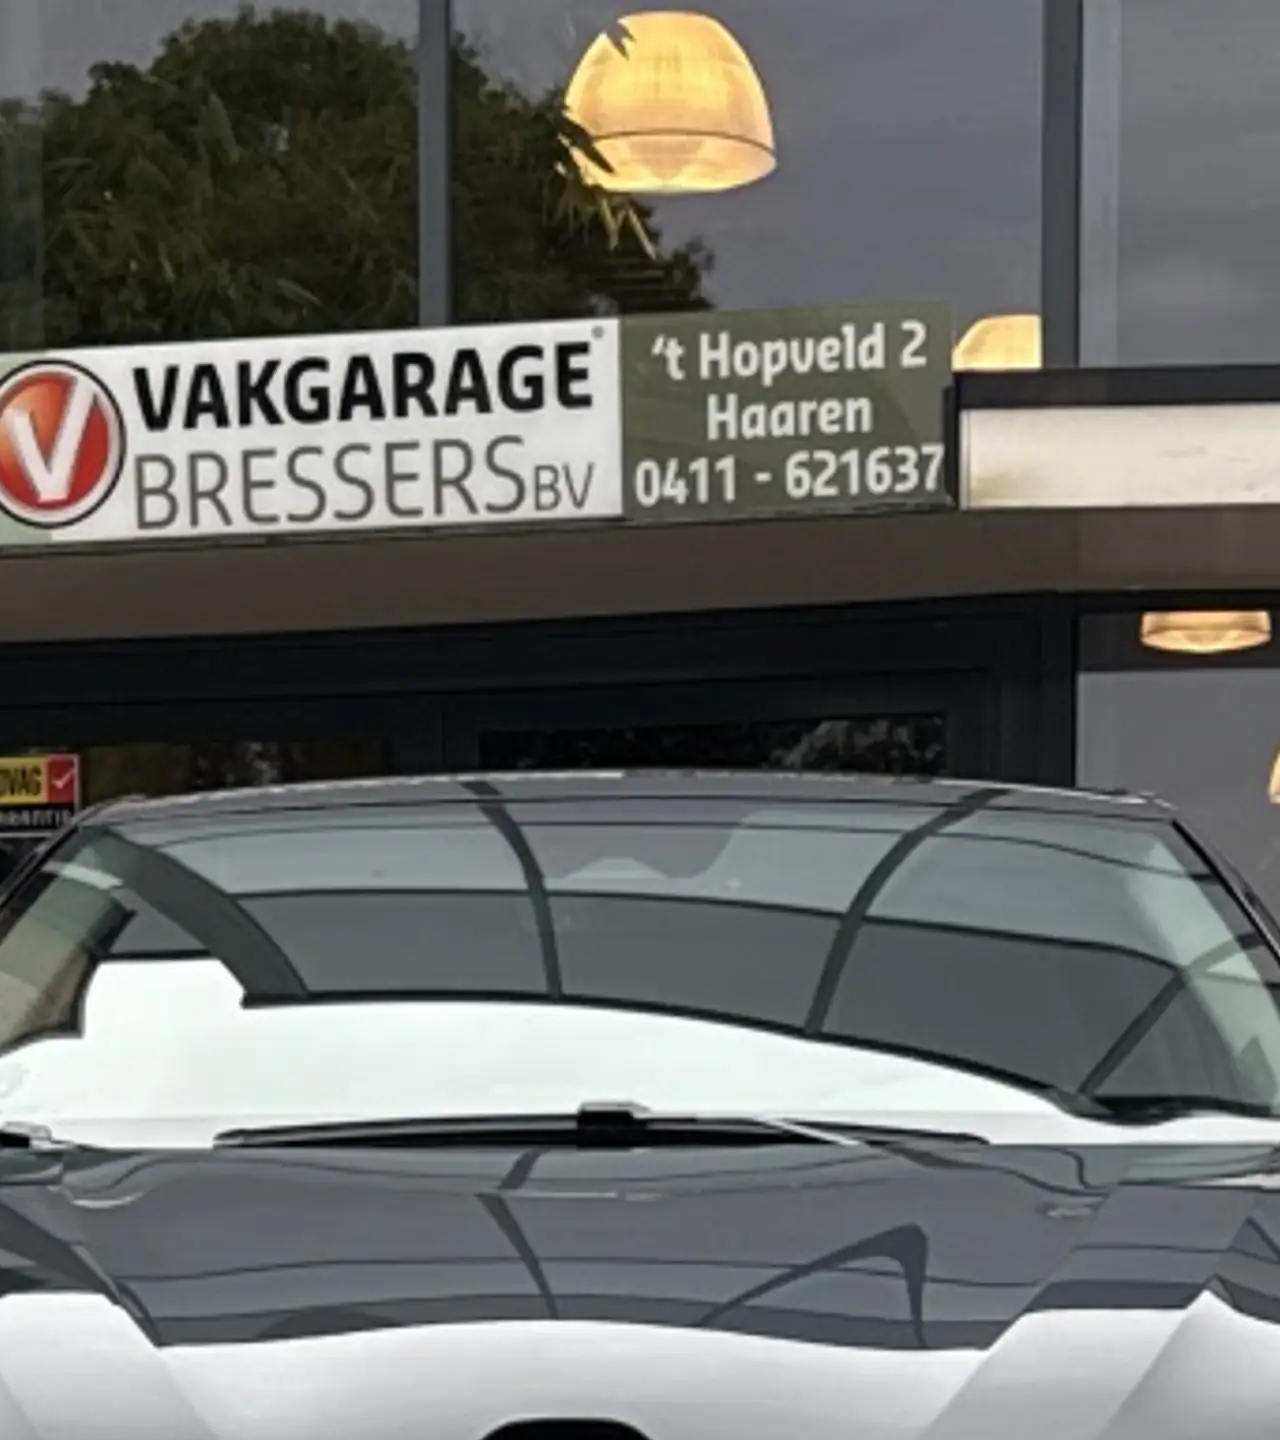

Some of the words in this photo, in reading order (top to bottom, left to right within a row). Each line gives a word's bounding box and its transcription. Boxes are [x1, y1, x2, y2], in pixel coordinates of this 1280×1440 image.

[133, 341, 594, 430] VAKGARAGE
[699, 322, 886, 387] Hopveld
[900, 319, 927, 368] 2
[706, 393, 873, 441] Haaren
[634, 455, 736, 508] 0411
[784, 444, 945, 499] 621637
